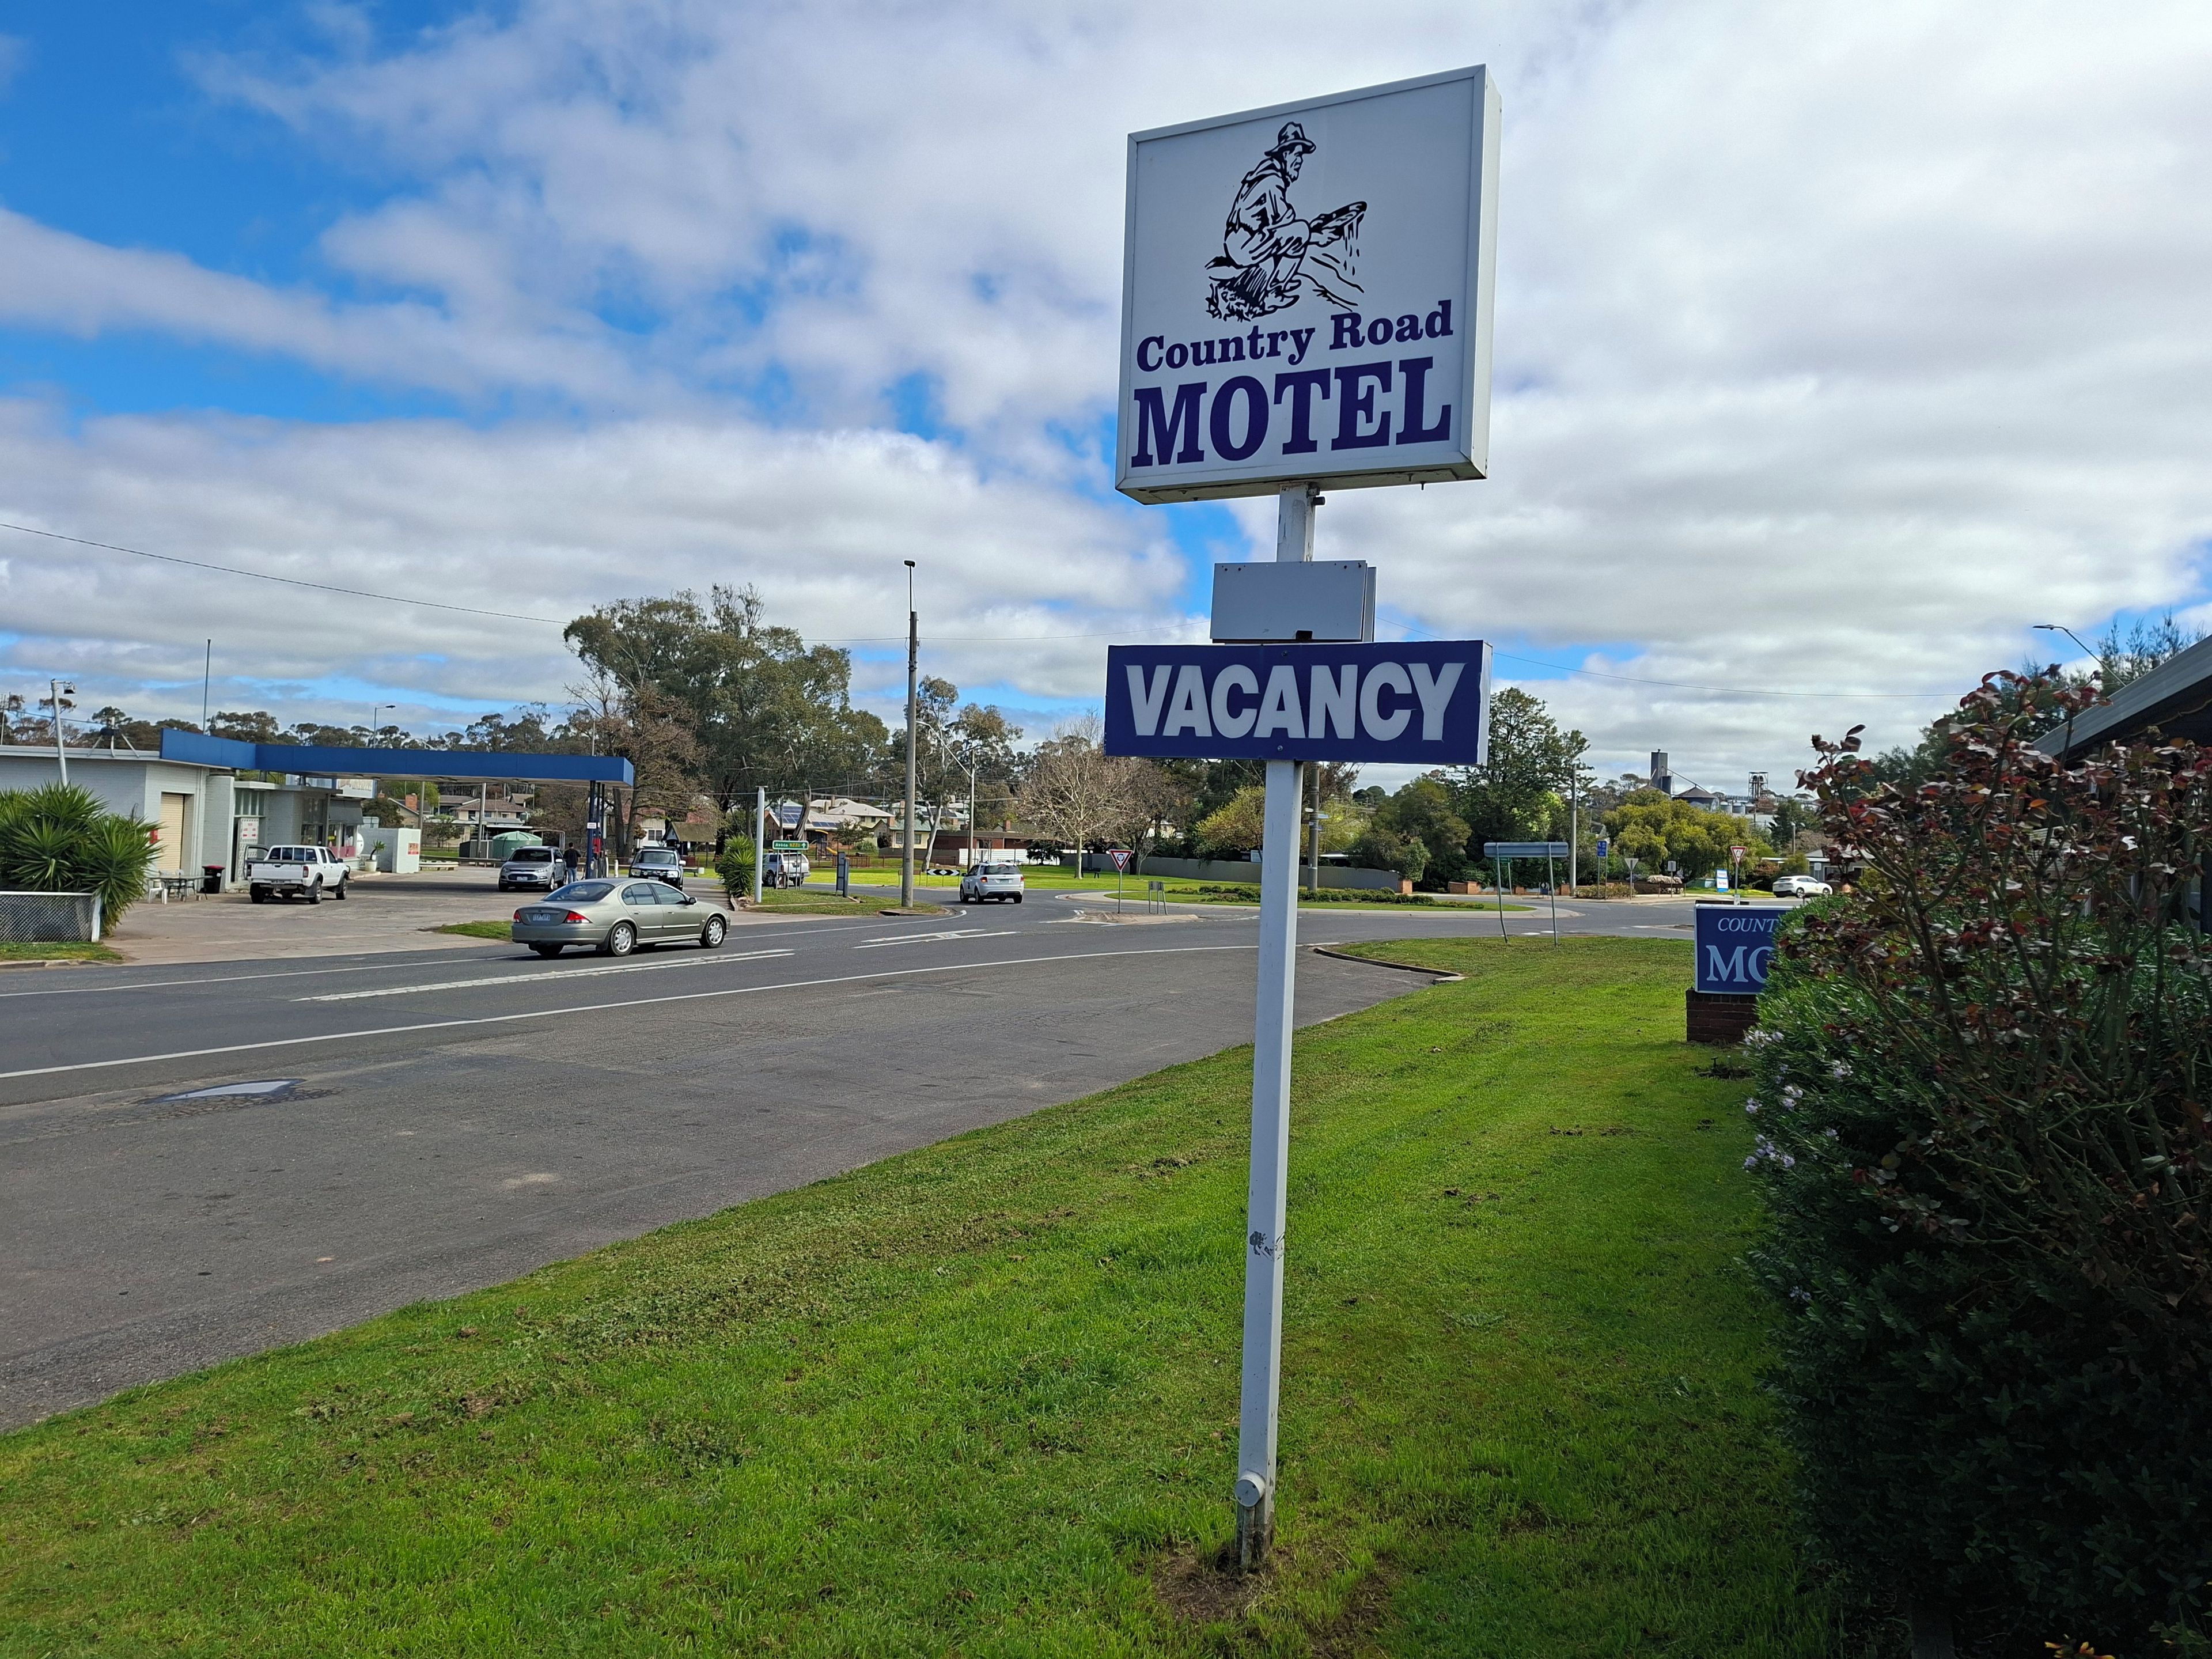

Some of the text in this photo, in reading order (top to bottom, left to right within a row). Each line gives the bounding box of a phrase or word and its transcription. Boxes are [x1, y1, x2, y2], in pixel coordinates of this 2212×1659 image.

[1137, 300, 1453, 372] Country Road
[1131, 357, 1452, 468] MOTEL
[1126, 662, 1465, 741] VACANCY
